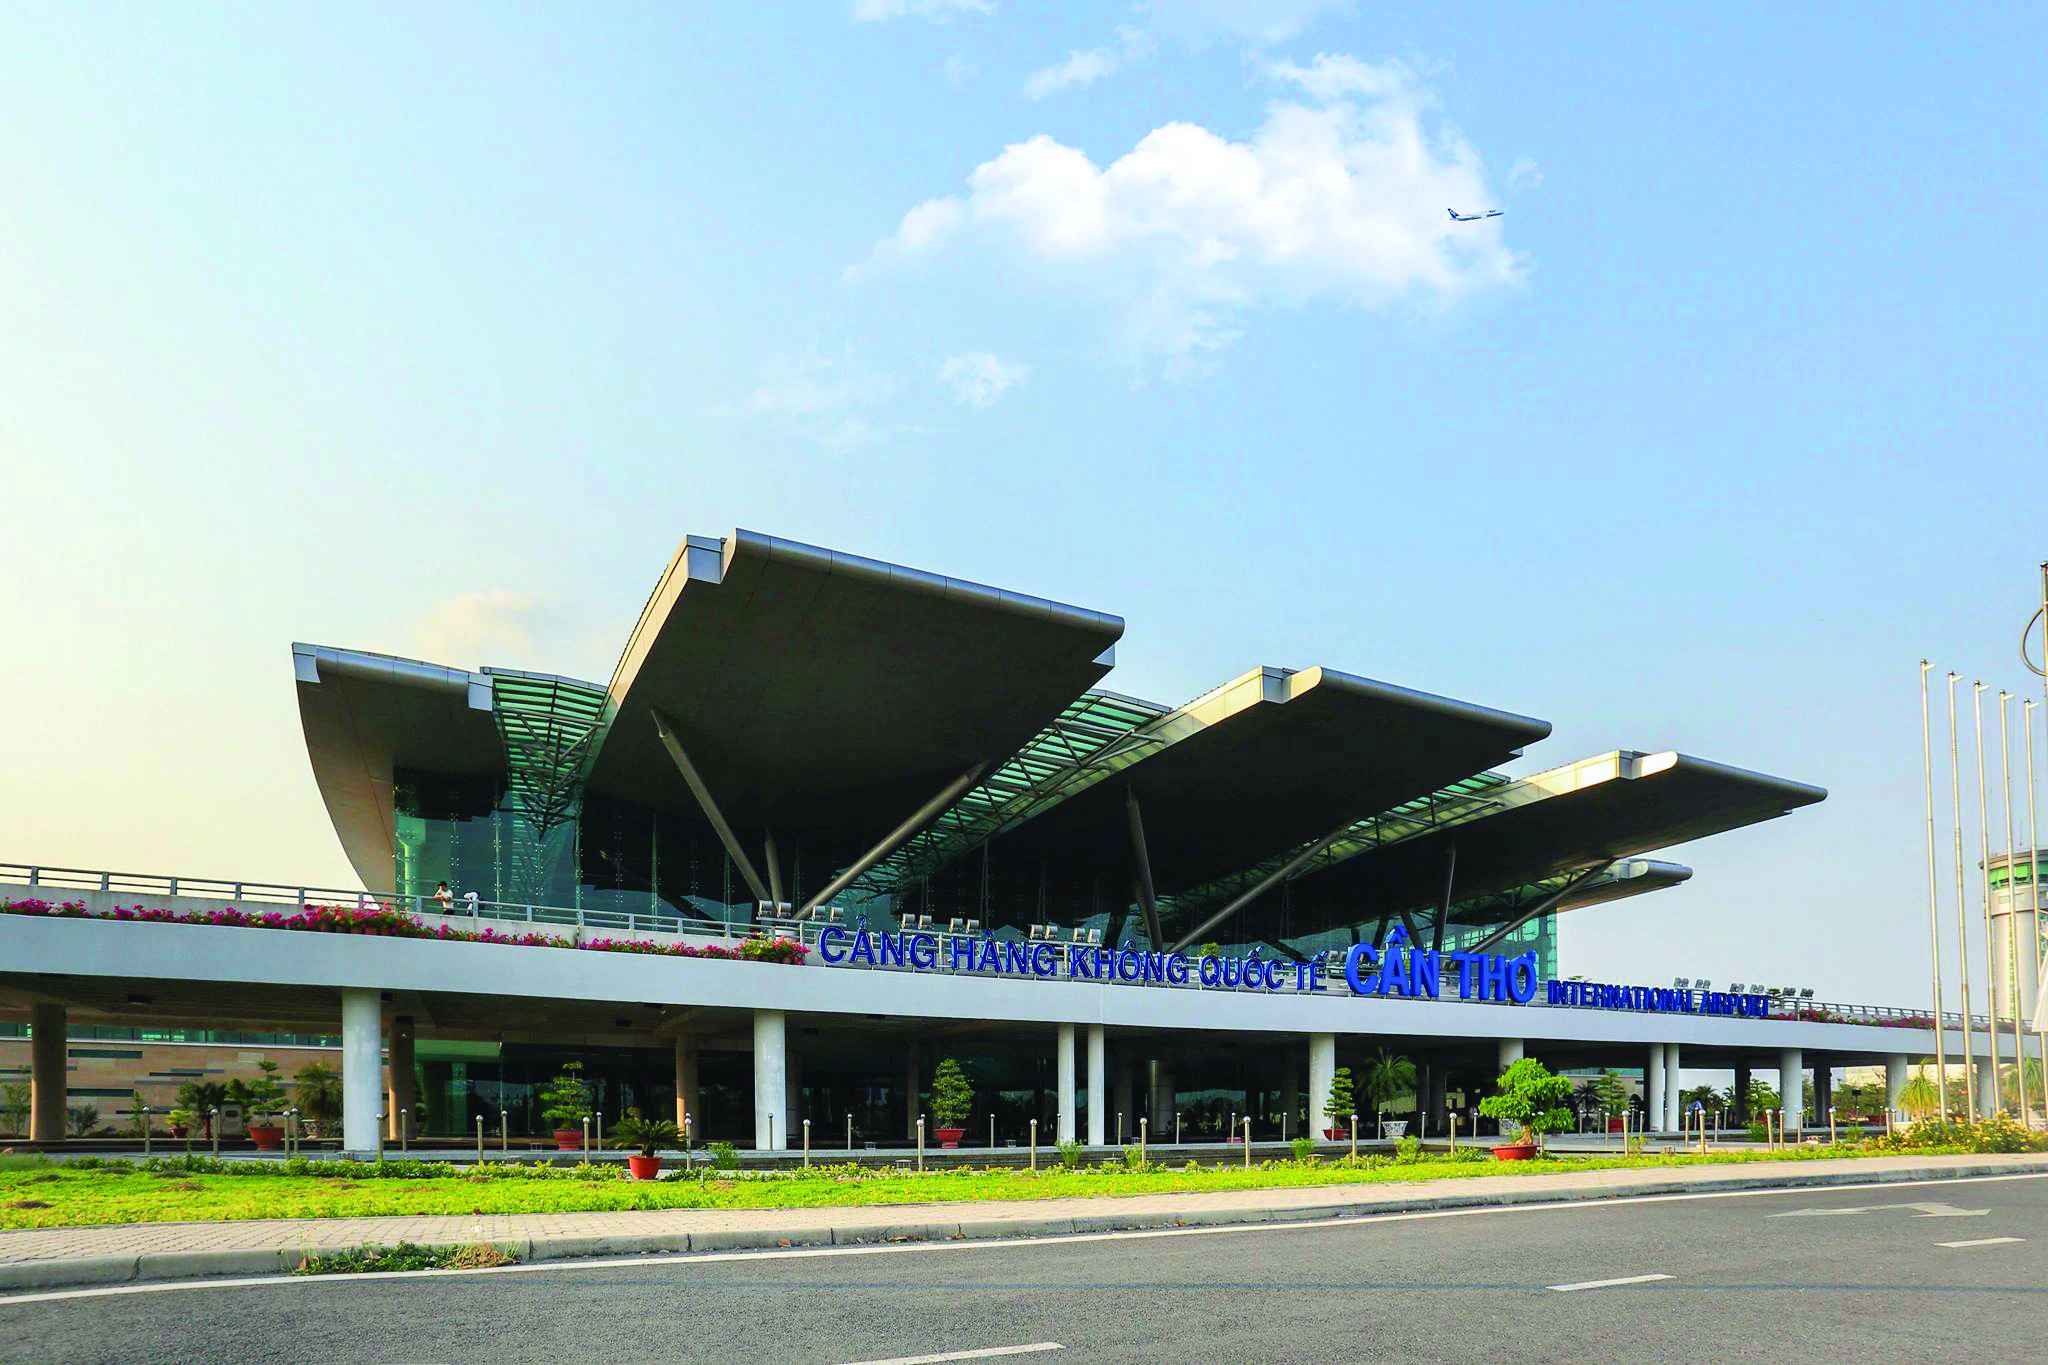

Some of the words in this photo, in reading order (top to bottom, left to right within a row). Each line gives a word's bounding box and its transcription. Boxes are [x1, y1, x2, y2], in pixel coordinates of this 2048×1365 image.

[819, 914, 937, 969] CẢNG
[951, 929, 1058, 977] HÀNG
[1070, 938, 1190, 985] KHÔNG
[1199, 946, 1285, 990] QUỐC
[1291, 950, 1328, 993] TẾ
[1345, 924, 1440, 998] CẦN
[1451, 950, 1537, 1003] THƠ
[1548, 979, 1698, 1013] INTERNATIONAL
[1699, 990, 1769, 1017] AIRPORT
